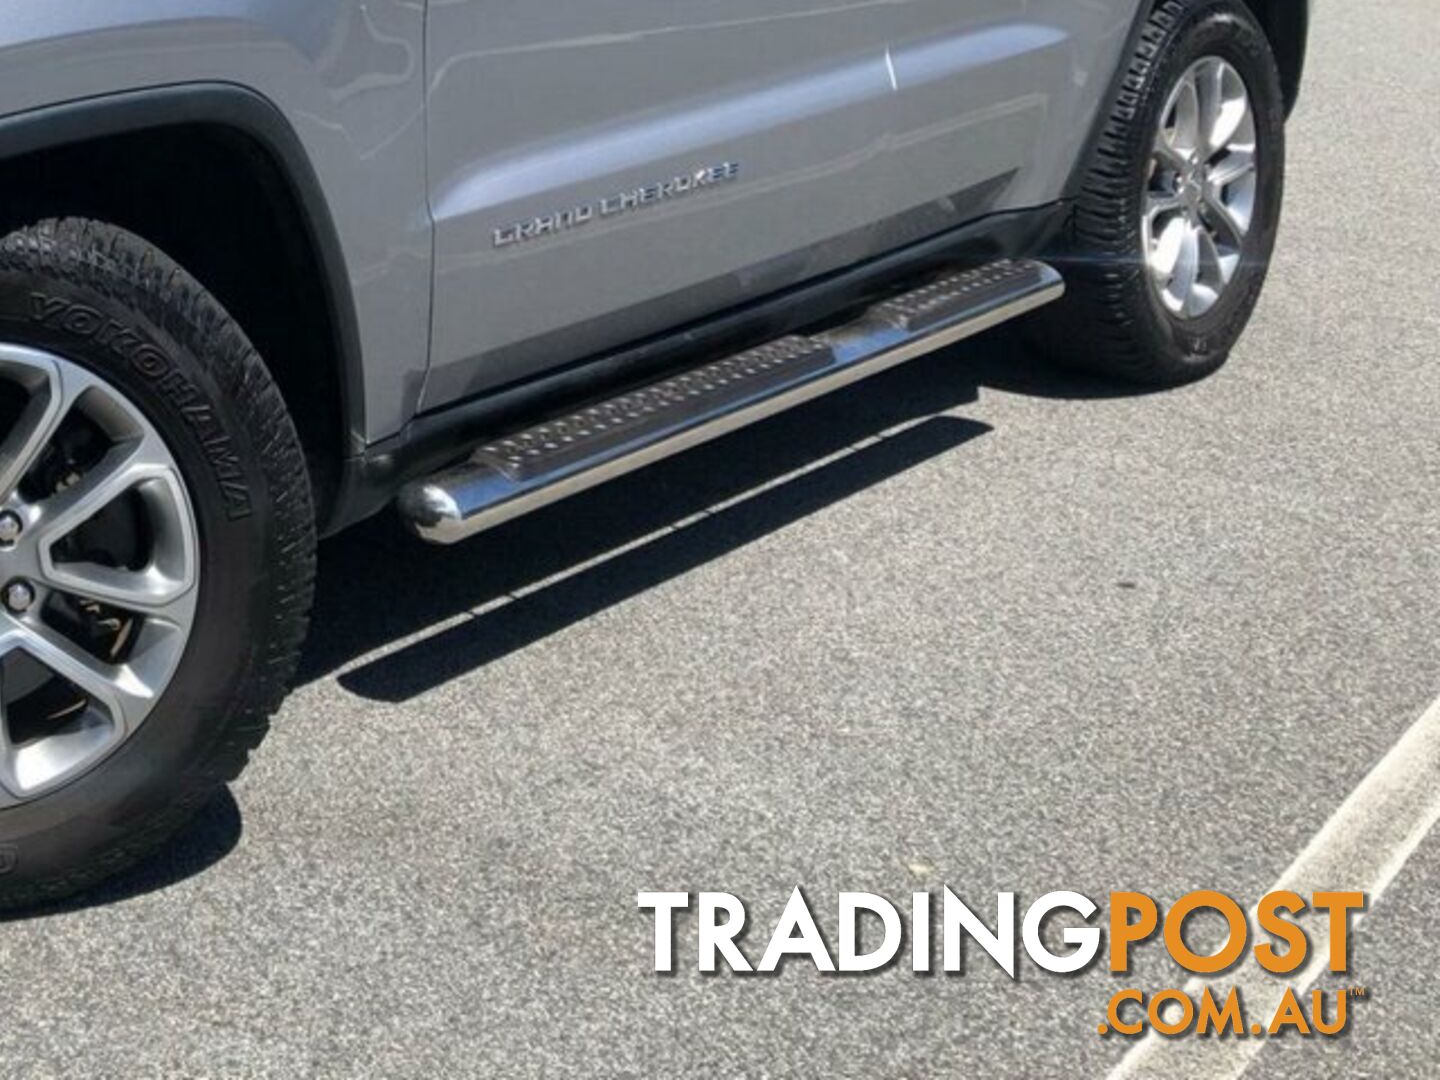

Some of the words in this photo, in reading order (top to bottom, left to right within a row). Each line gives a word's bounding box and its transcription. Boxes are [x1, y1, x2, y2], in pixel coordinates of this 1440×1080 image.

[493, 204, 592, 247] GRAND
[600, 161, 740, 216] CHEROKEE
[29, 291, 253, 521] YOKOHAMA
